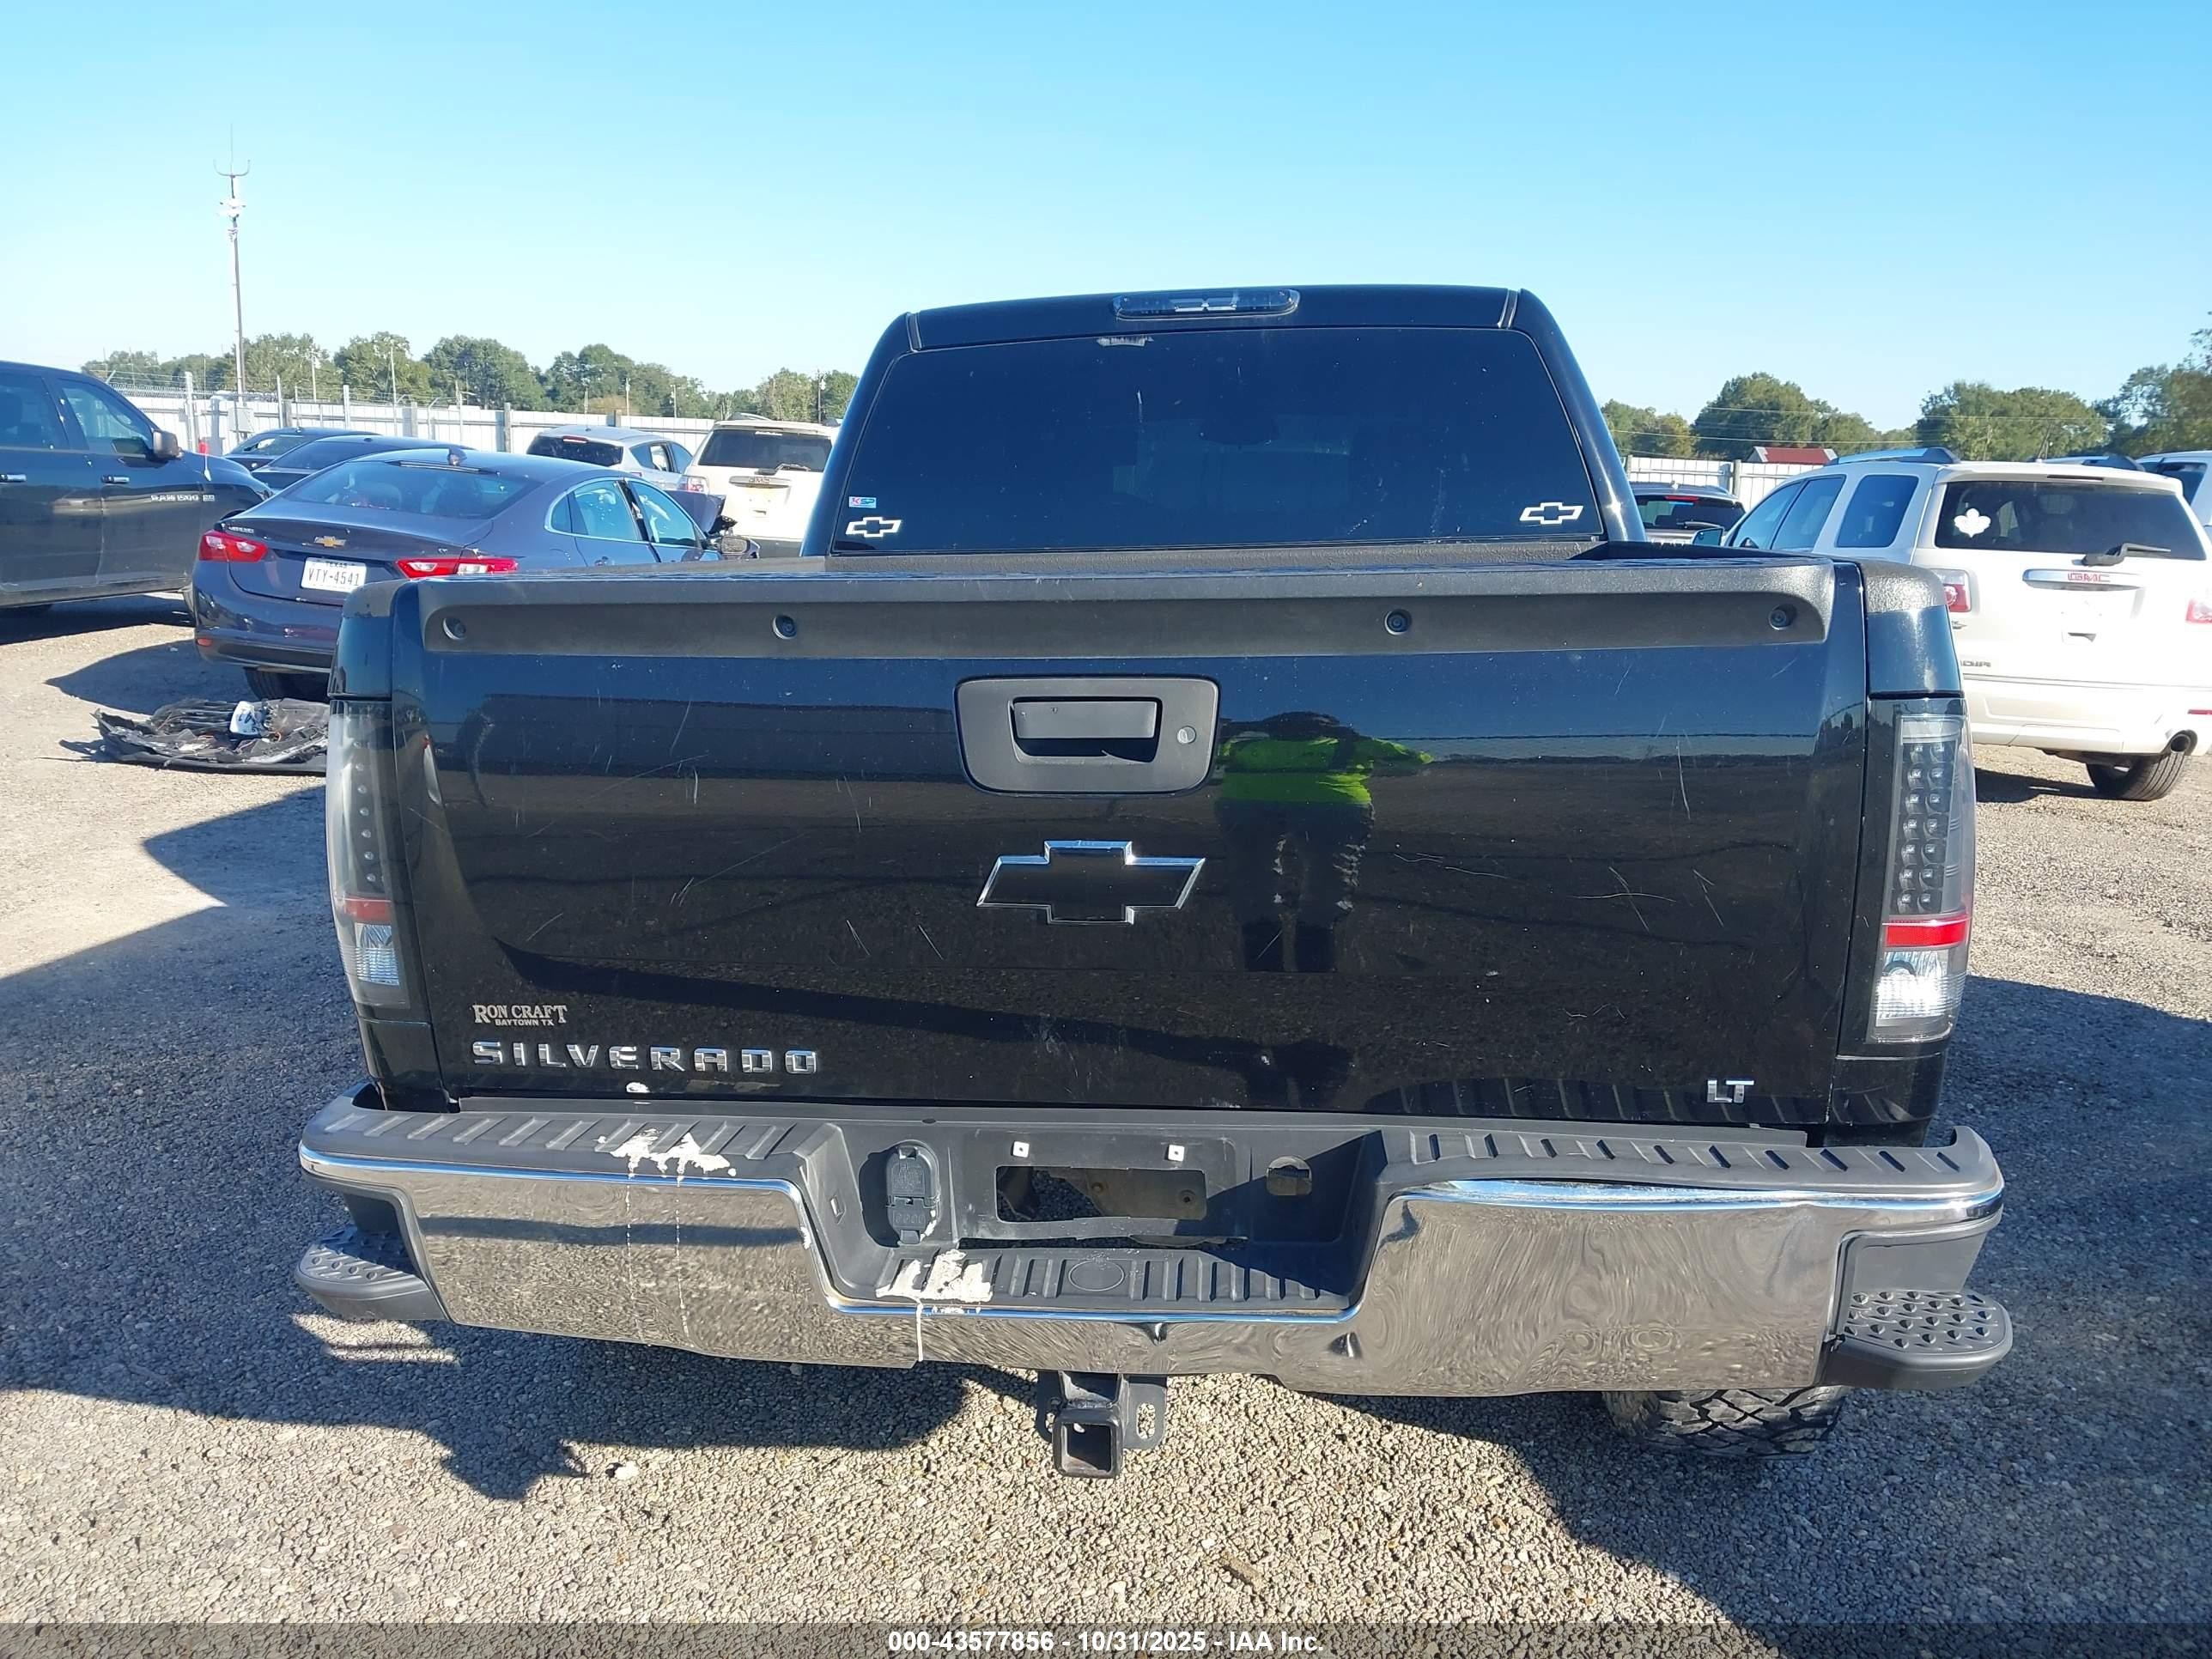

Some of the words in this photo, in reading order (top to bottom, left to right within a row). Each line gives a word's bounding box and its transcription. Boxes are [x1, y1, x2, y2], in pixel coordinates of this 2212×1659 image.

[308, 568, 360, 586] VTY-4541
[472, 1005, 508, 1023] RON
[511, 1005, 568, 1024] CRAFT
[472, 1041, 817, 1074] SILVERADO
[1706, 1079, 1754, 1103] LT
